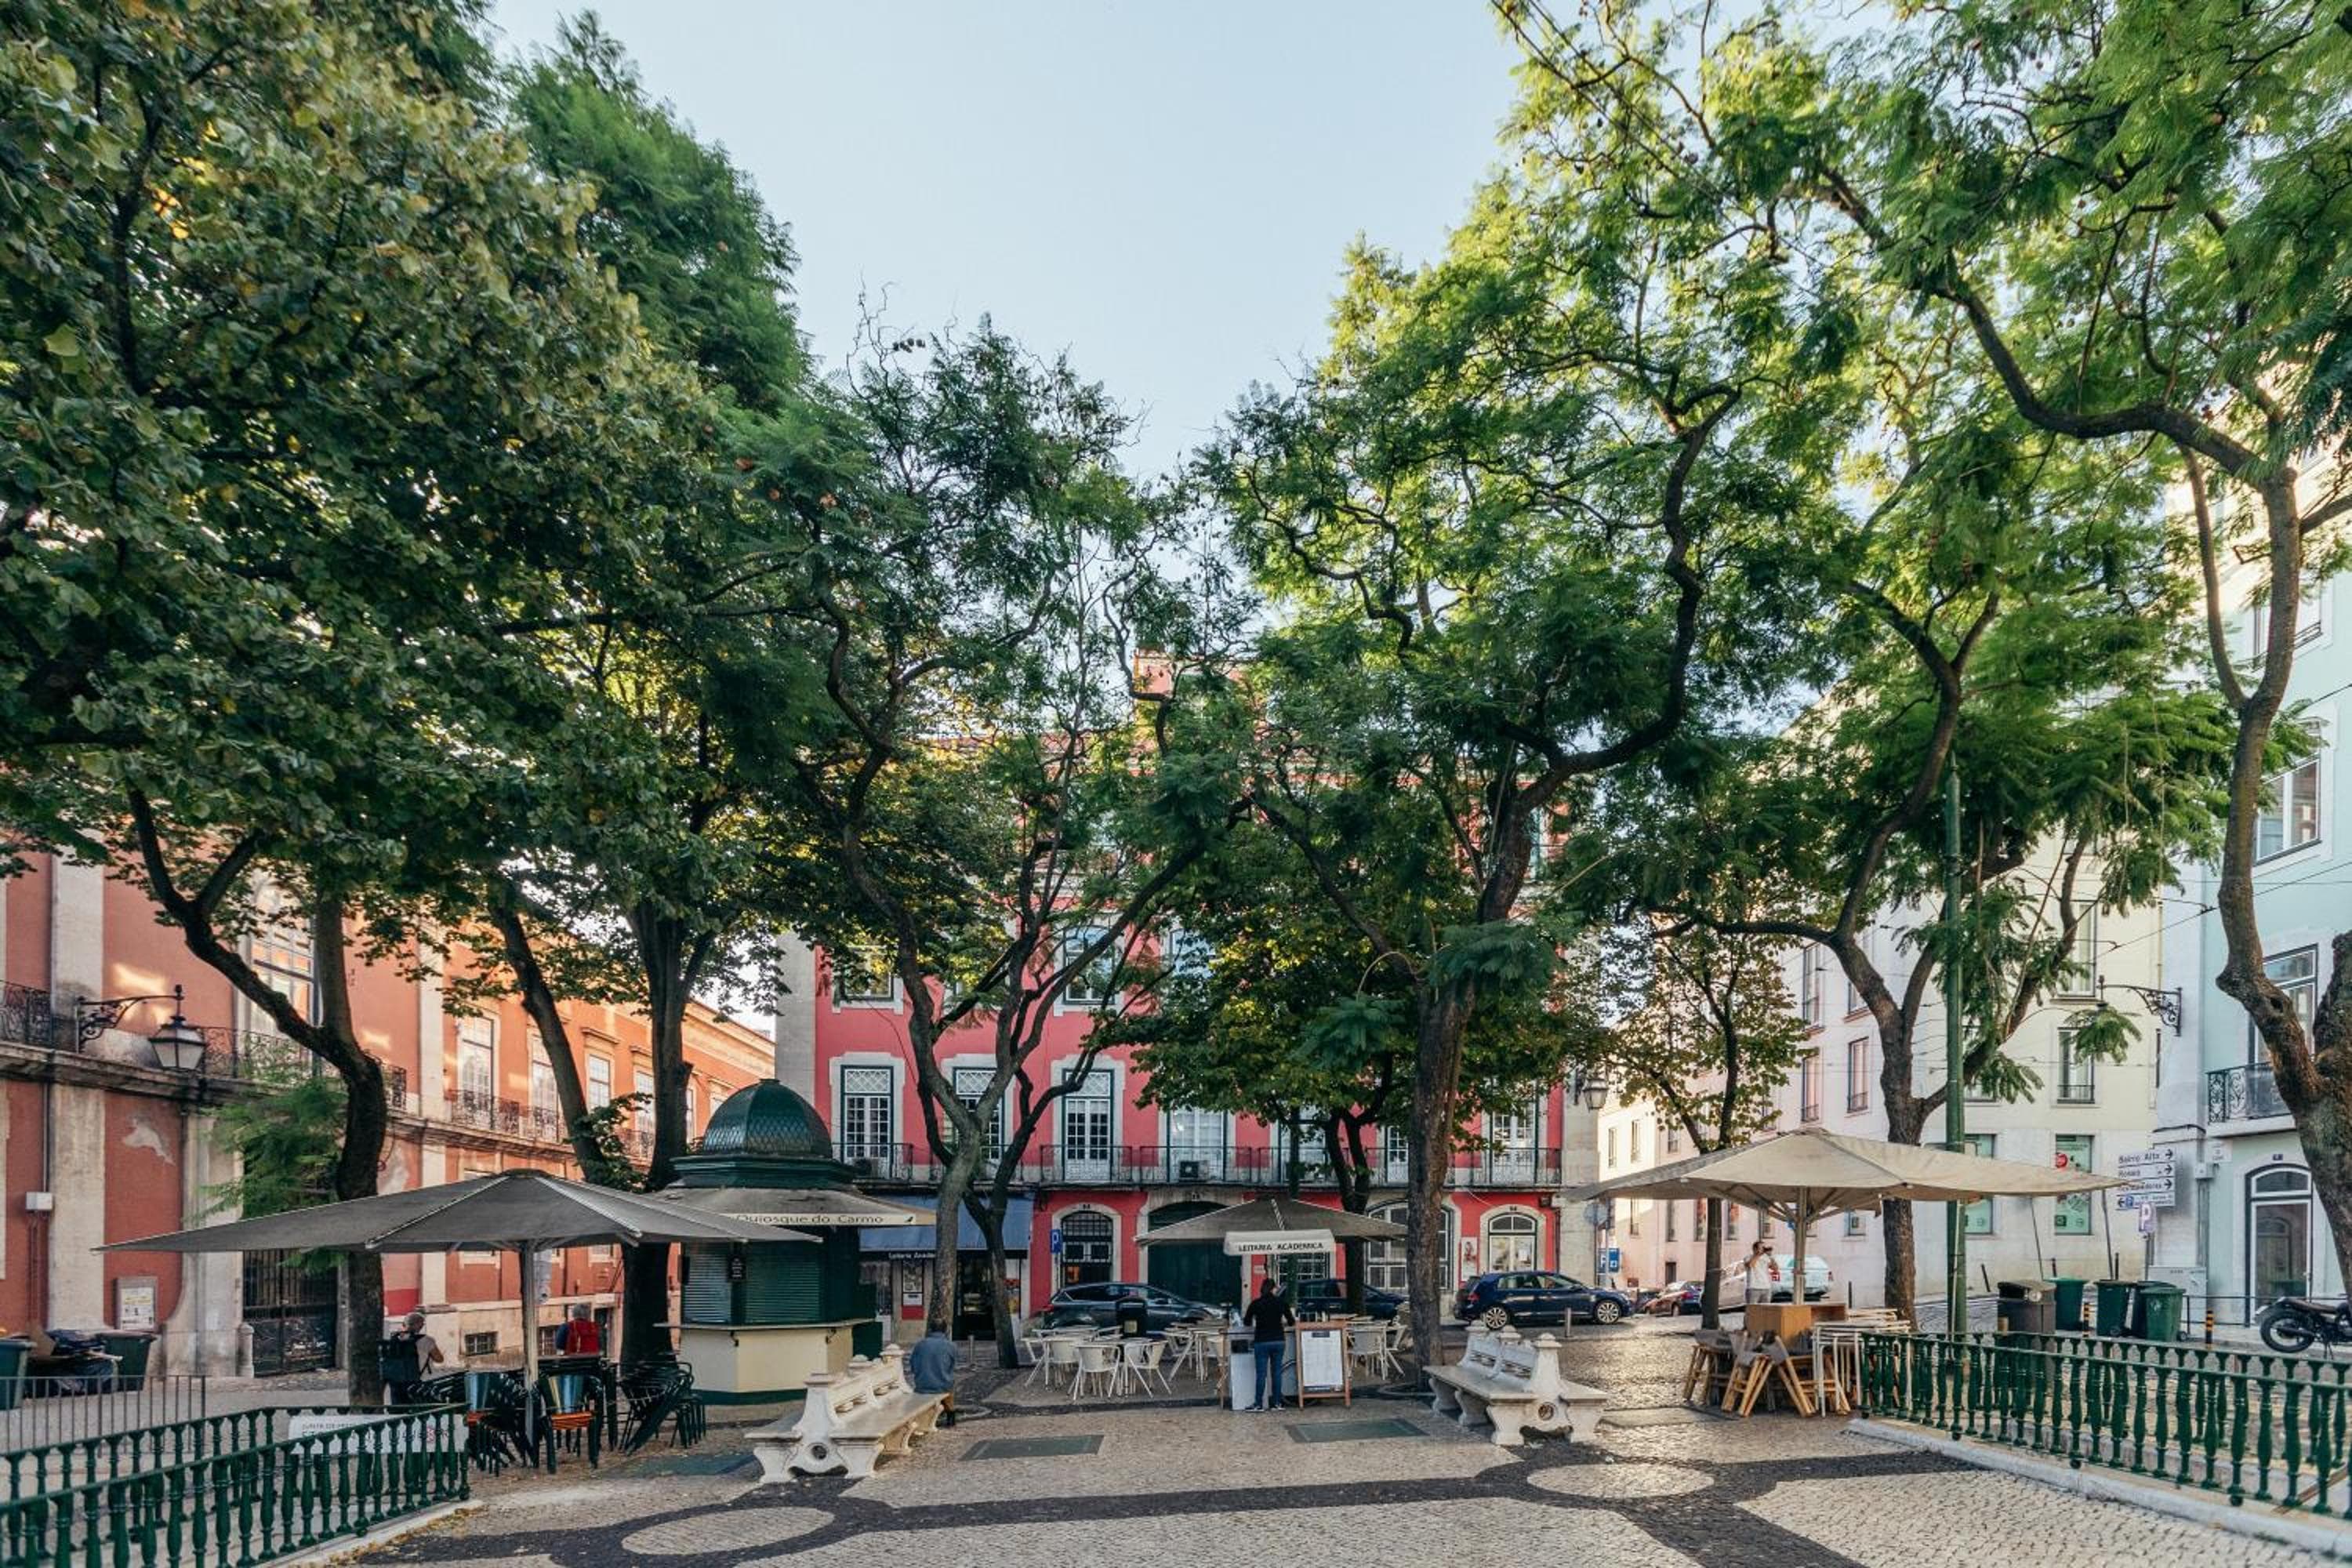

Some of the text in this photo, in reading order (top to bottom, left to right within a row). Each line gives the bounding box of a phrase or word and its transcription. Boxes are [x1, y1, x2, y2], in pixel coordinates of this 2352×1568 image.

[811, 1214, 830, 1223] do
[837, 1214, 884, 1223] Carmo
[2140, 1203, 2152, 1230] P
